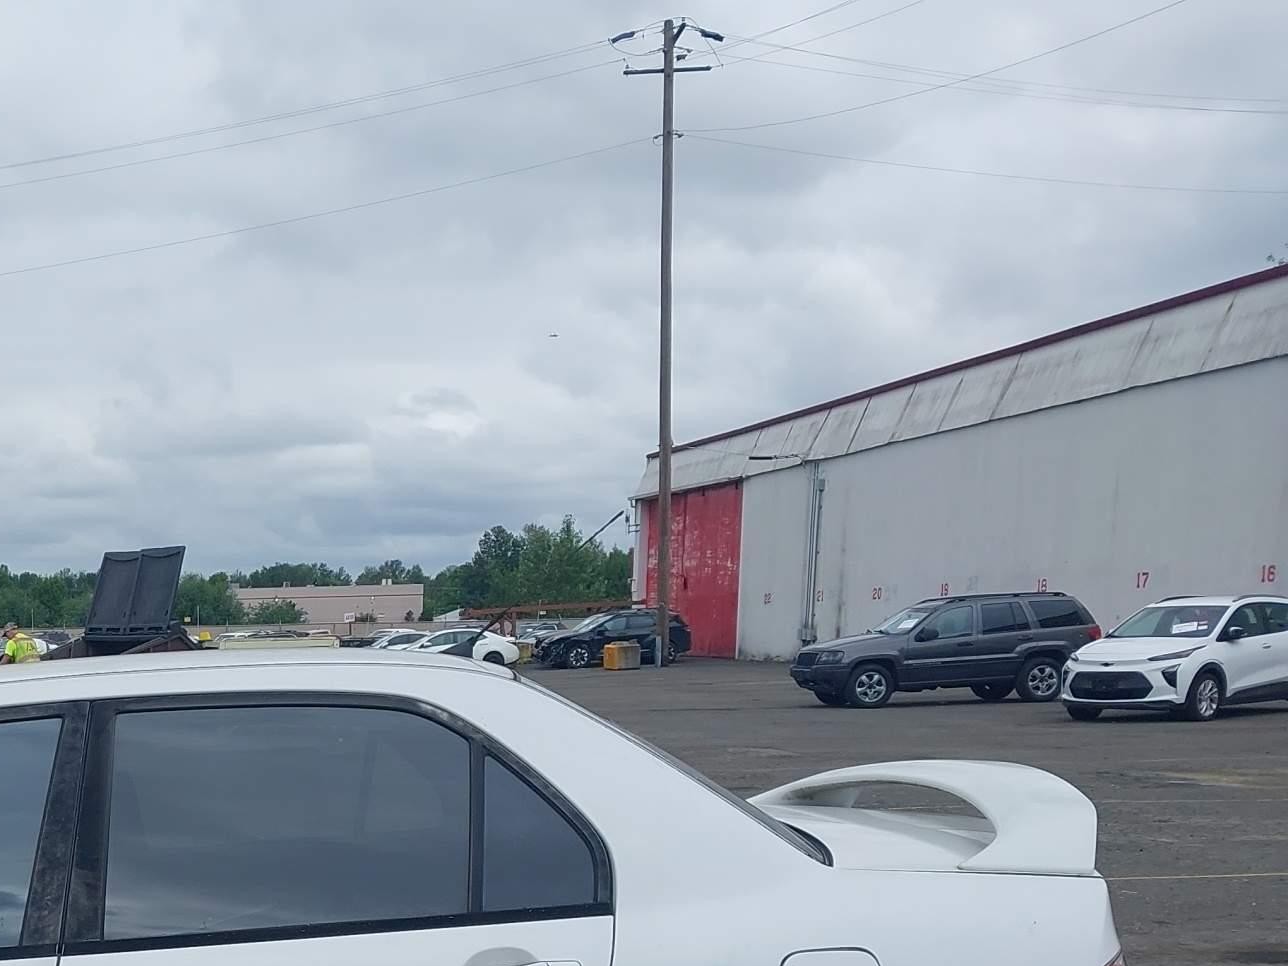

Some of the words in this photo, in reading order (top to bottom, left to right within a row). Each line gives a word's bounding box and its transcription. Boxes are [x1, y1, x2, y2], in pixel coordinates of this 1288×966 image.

[1136, 572, 1150, 589] 17
[1261, 564, 1277, 583] 16
[1036, 578, 1048, 592] 18
[872, 587, 882, 600] 20
